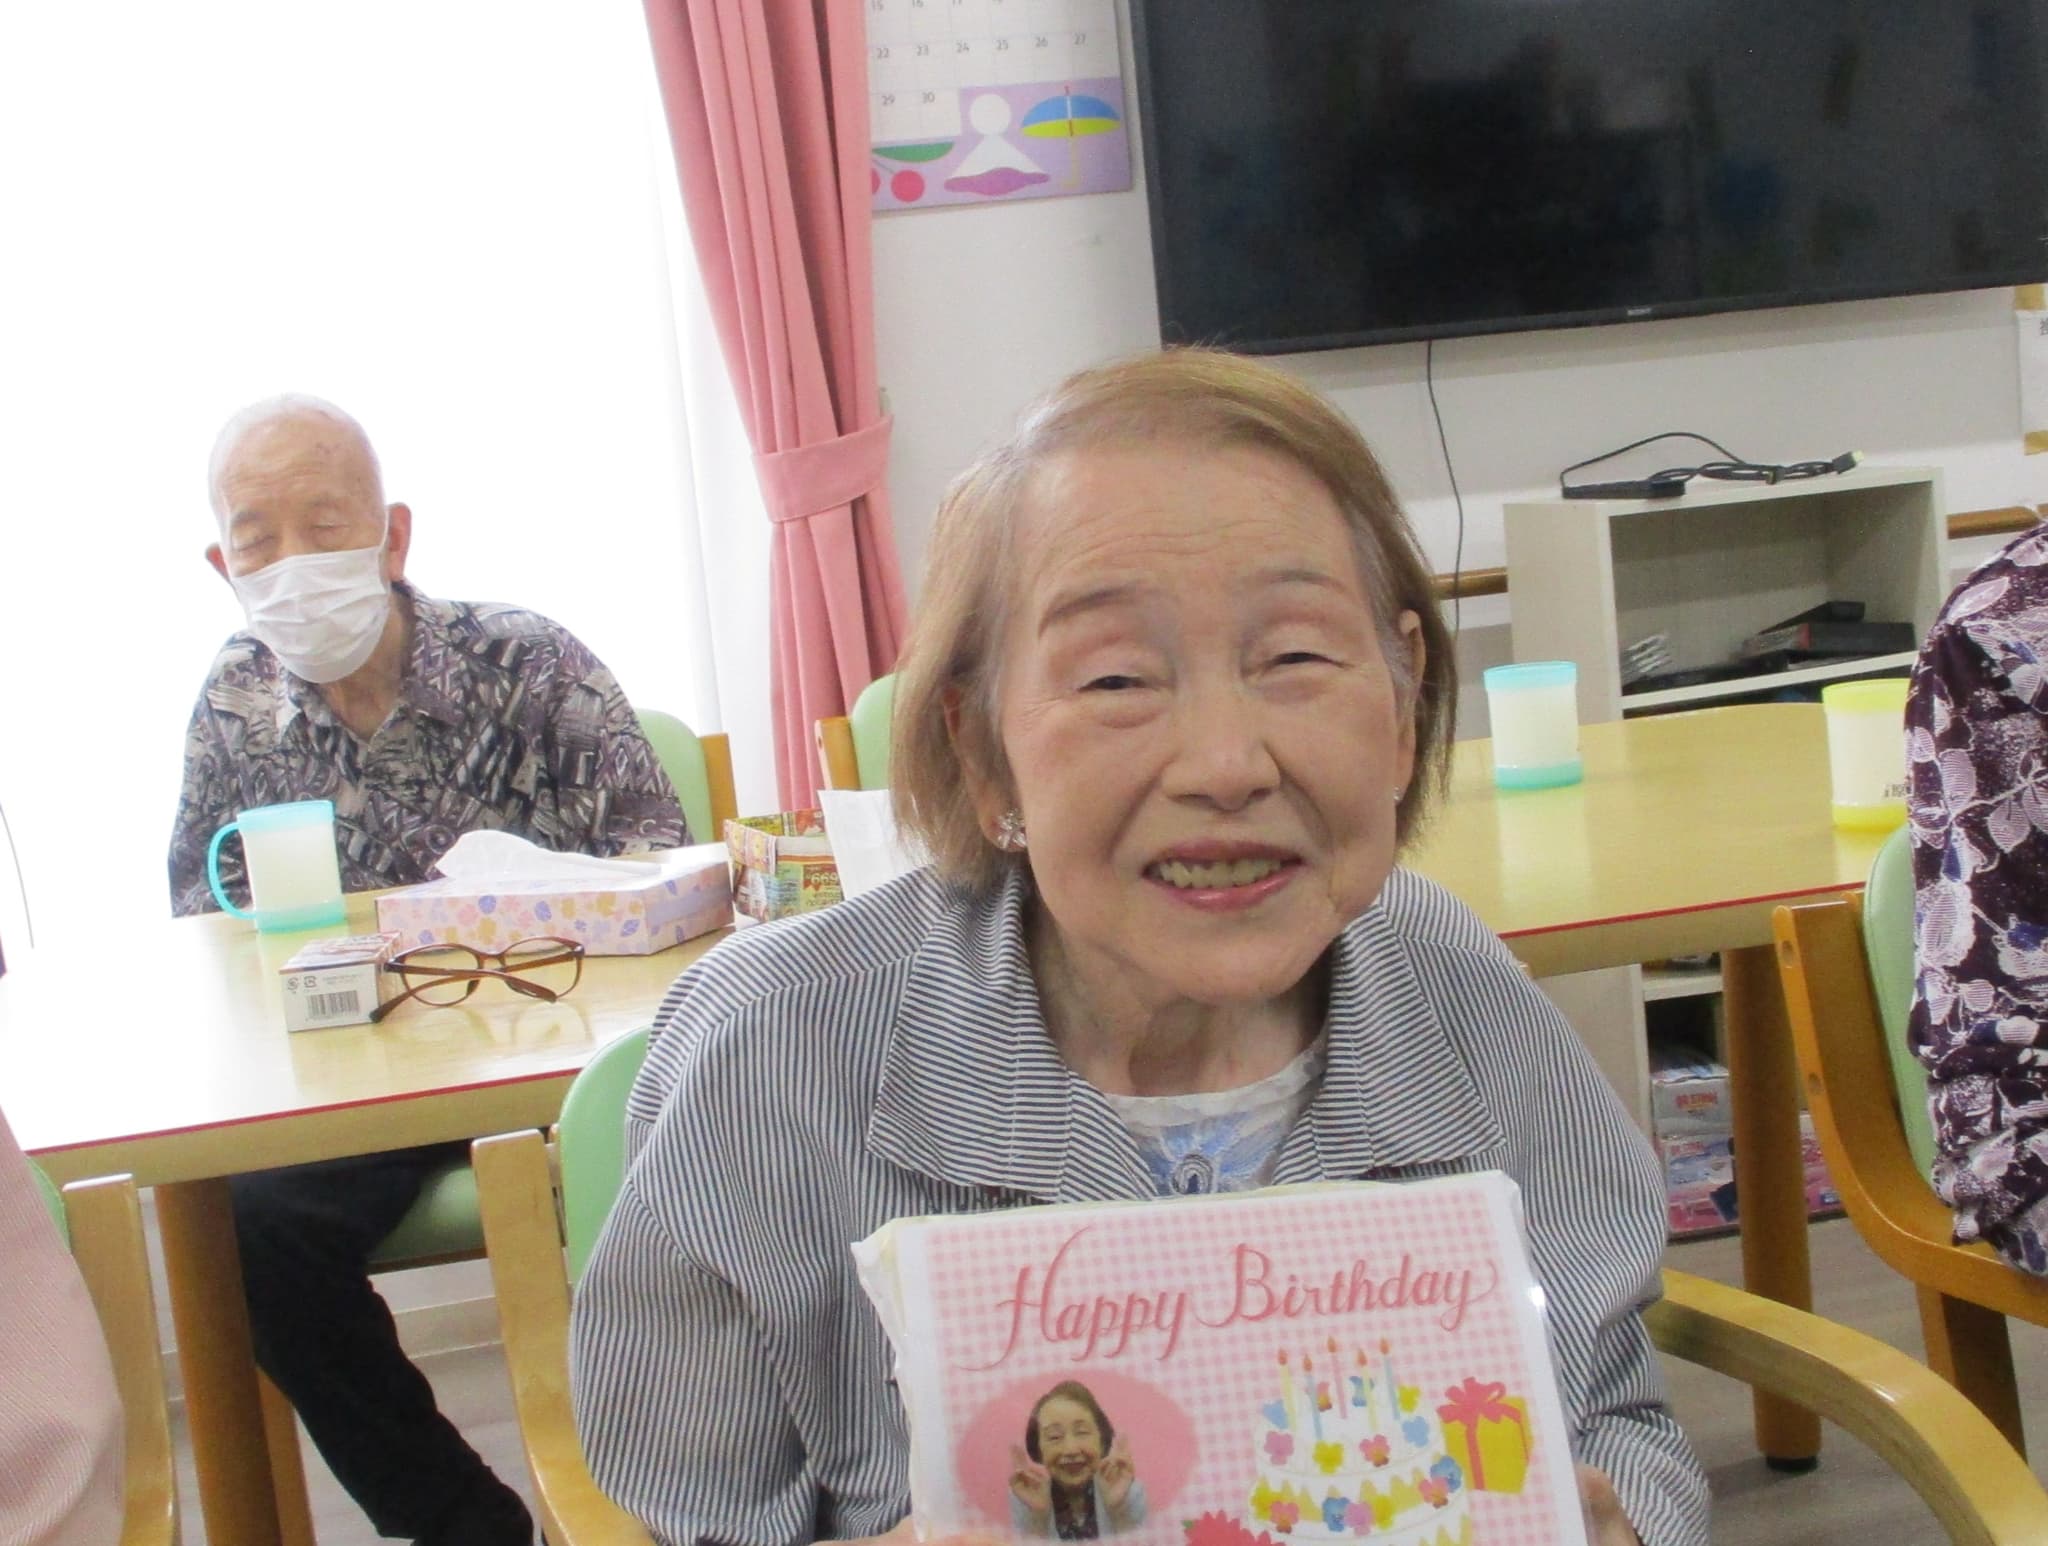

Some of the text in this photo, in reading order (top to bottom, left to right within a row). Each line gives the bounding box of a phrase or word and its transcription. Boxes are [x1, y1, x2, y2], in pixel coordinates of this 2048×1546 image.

[877, 33, 1087, 59] 22 23 24 25 26 27
[881, 92, 935, 106] 29 30
[952, 1226, 1497, 1371] Happy Birthday
